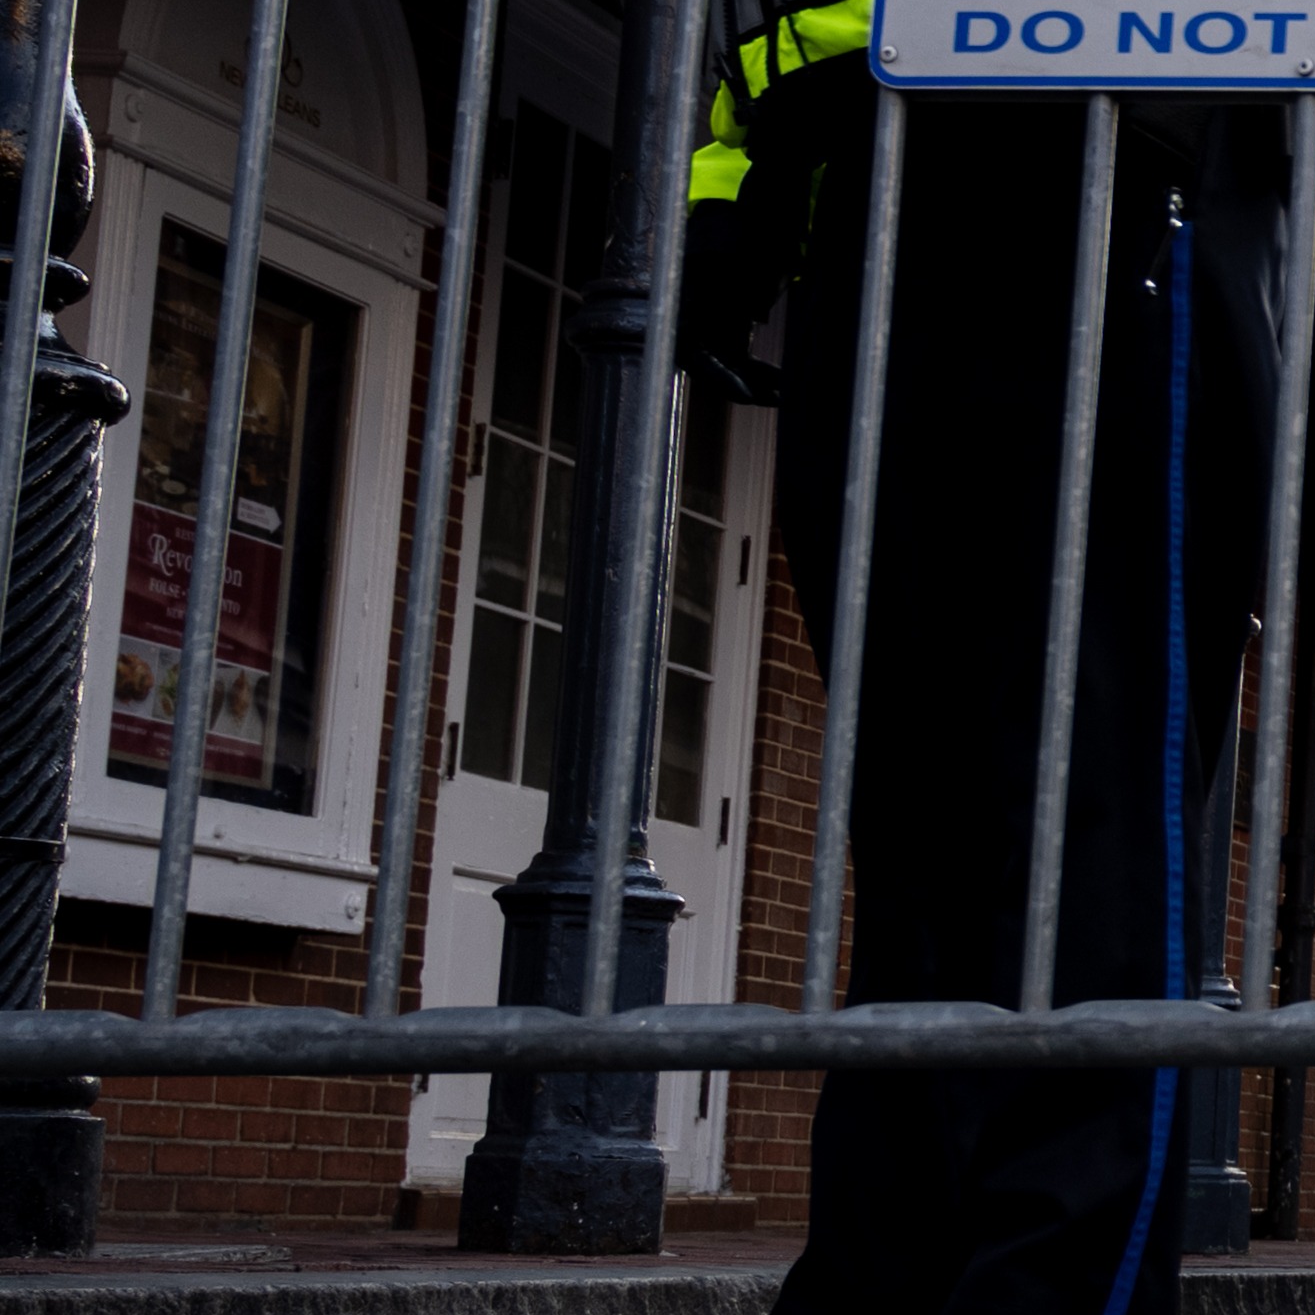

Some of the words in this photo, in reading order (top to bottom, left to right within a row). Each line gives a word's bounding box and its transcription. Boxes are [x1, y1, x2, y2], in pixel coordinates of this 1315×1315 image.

[952, 10, 1084, 55] DO
[1116, 11, 1308, 56] NOT
[219, 60, 246, 90] NE
